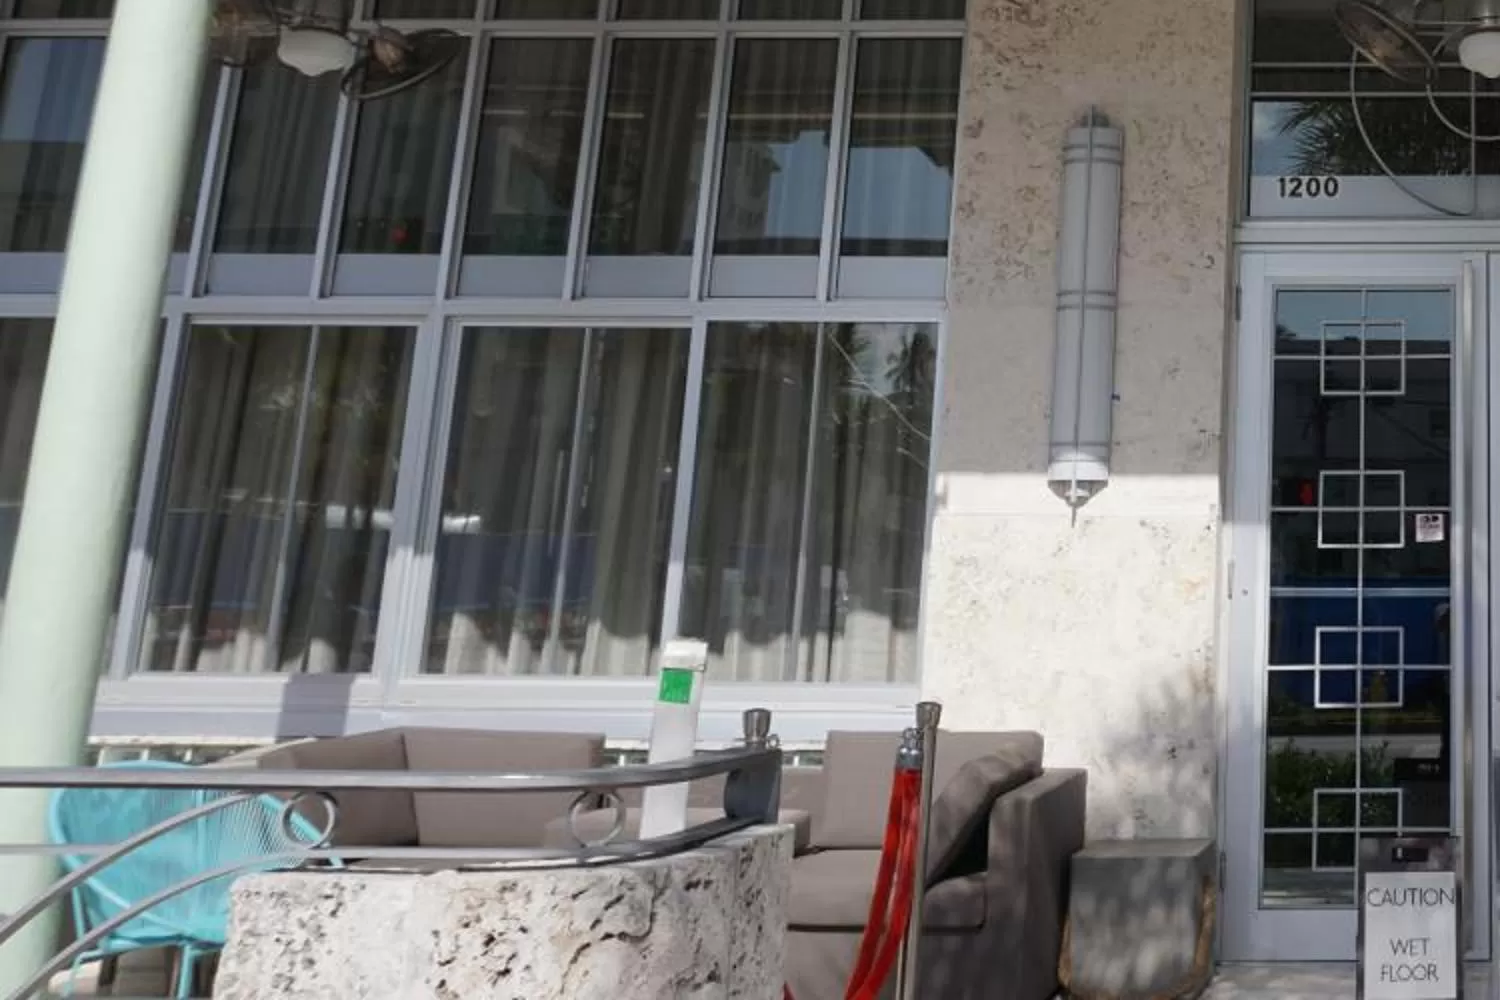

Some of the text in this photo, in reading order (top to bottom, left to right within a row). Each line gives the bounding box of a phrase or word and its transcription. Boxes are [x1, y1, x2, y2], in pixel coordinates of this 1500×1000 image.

[1277, 176, 1339, 199] 1200
[1366, 887, 1456, 907] CAUTION
[1389, 936, 1431, 957] WET
[1380, 963, 1440, 983] FLOOR
